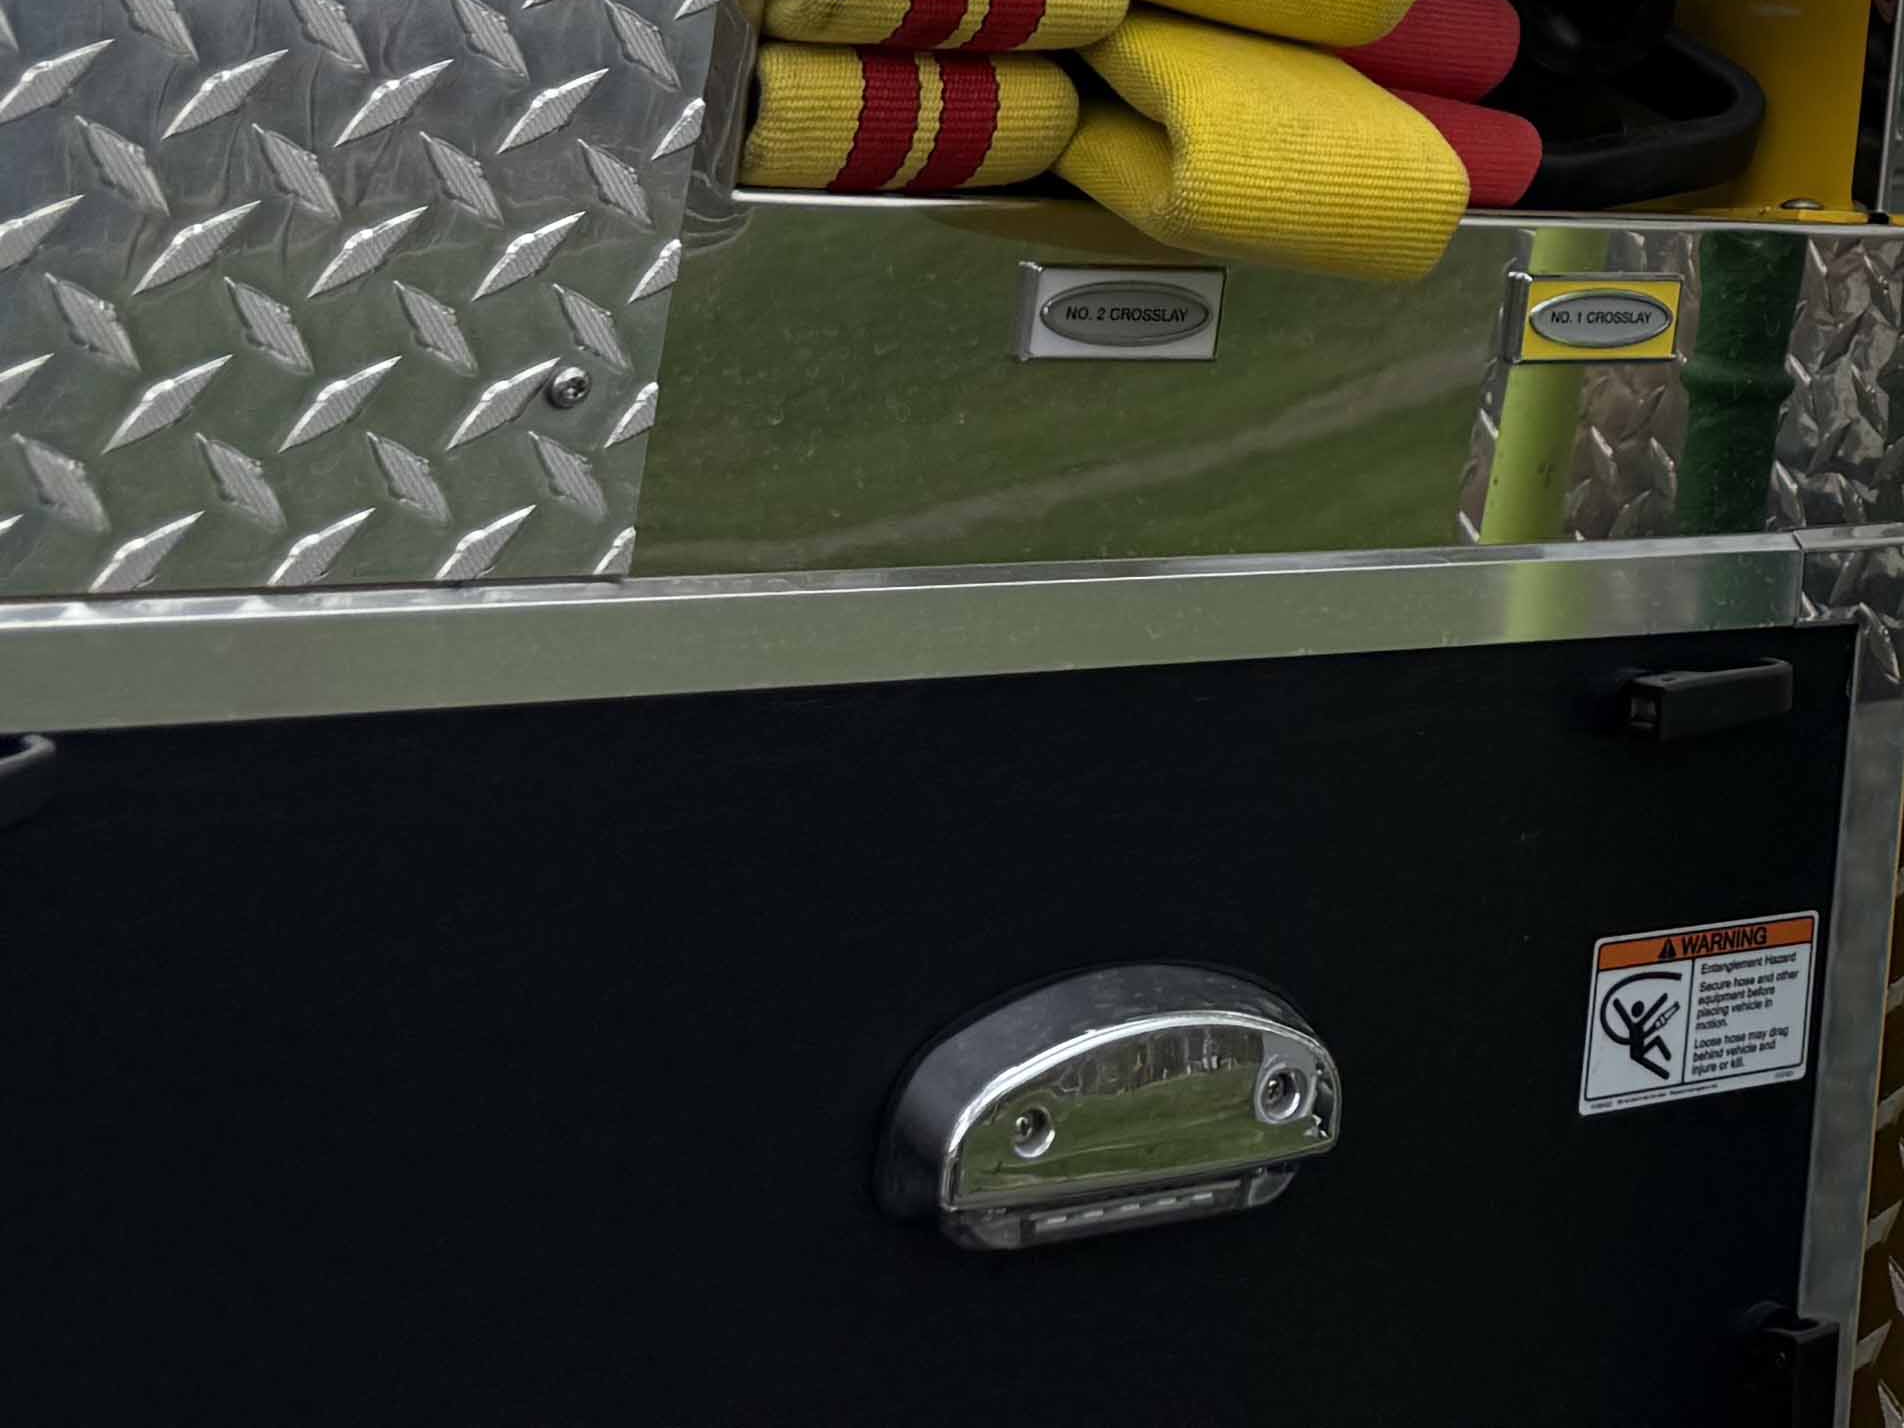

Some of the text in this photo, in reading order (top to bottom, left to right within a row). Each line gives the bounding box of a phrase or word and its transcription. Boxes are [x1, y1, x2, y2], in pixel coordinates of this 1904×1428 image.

[1065, 305, 1189, 322] NO. 2 CROSSLAY
[1551, 311, 1573, 323] NO.
[1586, 311, 1653, 324] CROSSLAY
[1681, 926, 1768, 956] WARNING
[1700, 952, 1797, 975] Entanglement Hazard
[1700, 970, 1799, 992] Secure hose and other
[1698, 986, 1775, 1006] equipment before
[1696, 998, 1773, 1020] placing vehicle in
[1694, 1026, 1790, 1049] Loose hose may drag
[1693, 1039, 1776, 1063] behind vehicle and
[1692, 1063, 1717, 1076] injure
[1719, 1061, 1728, 1071] or
